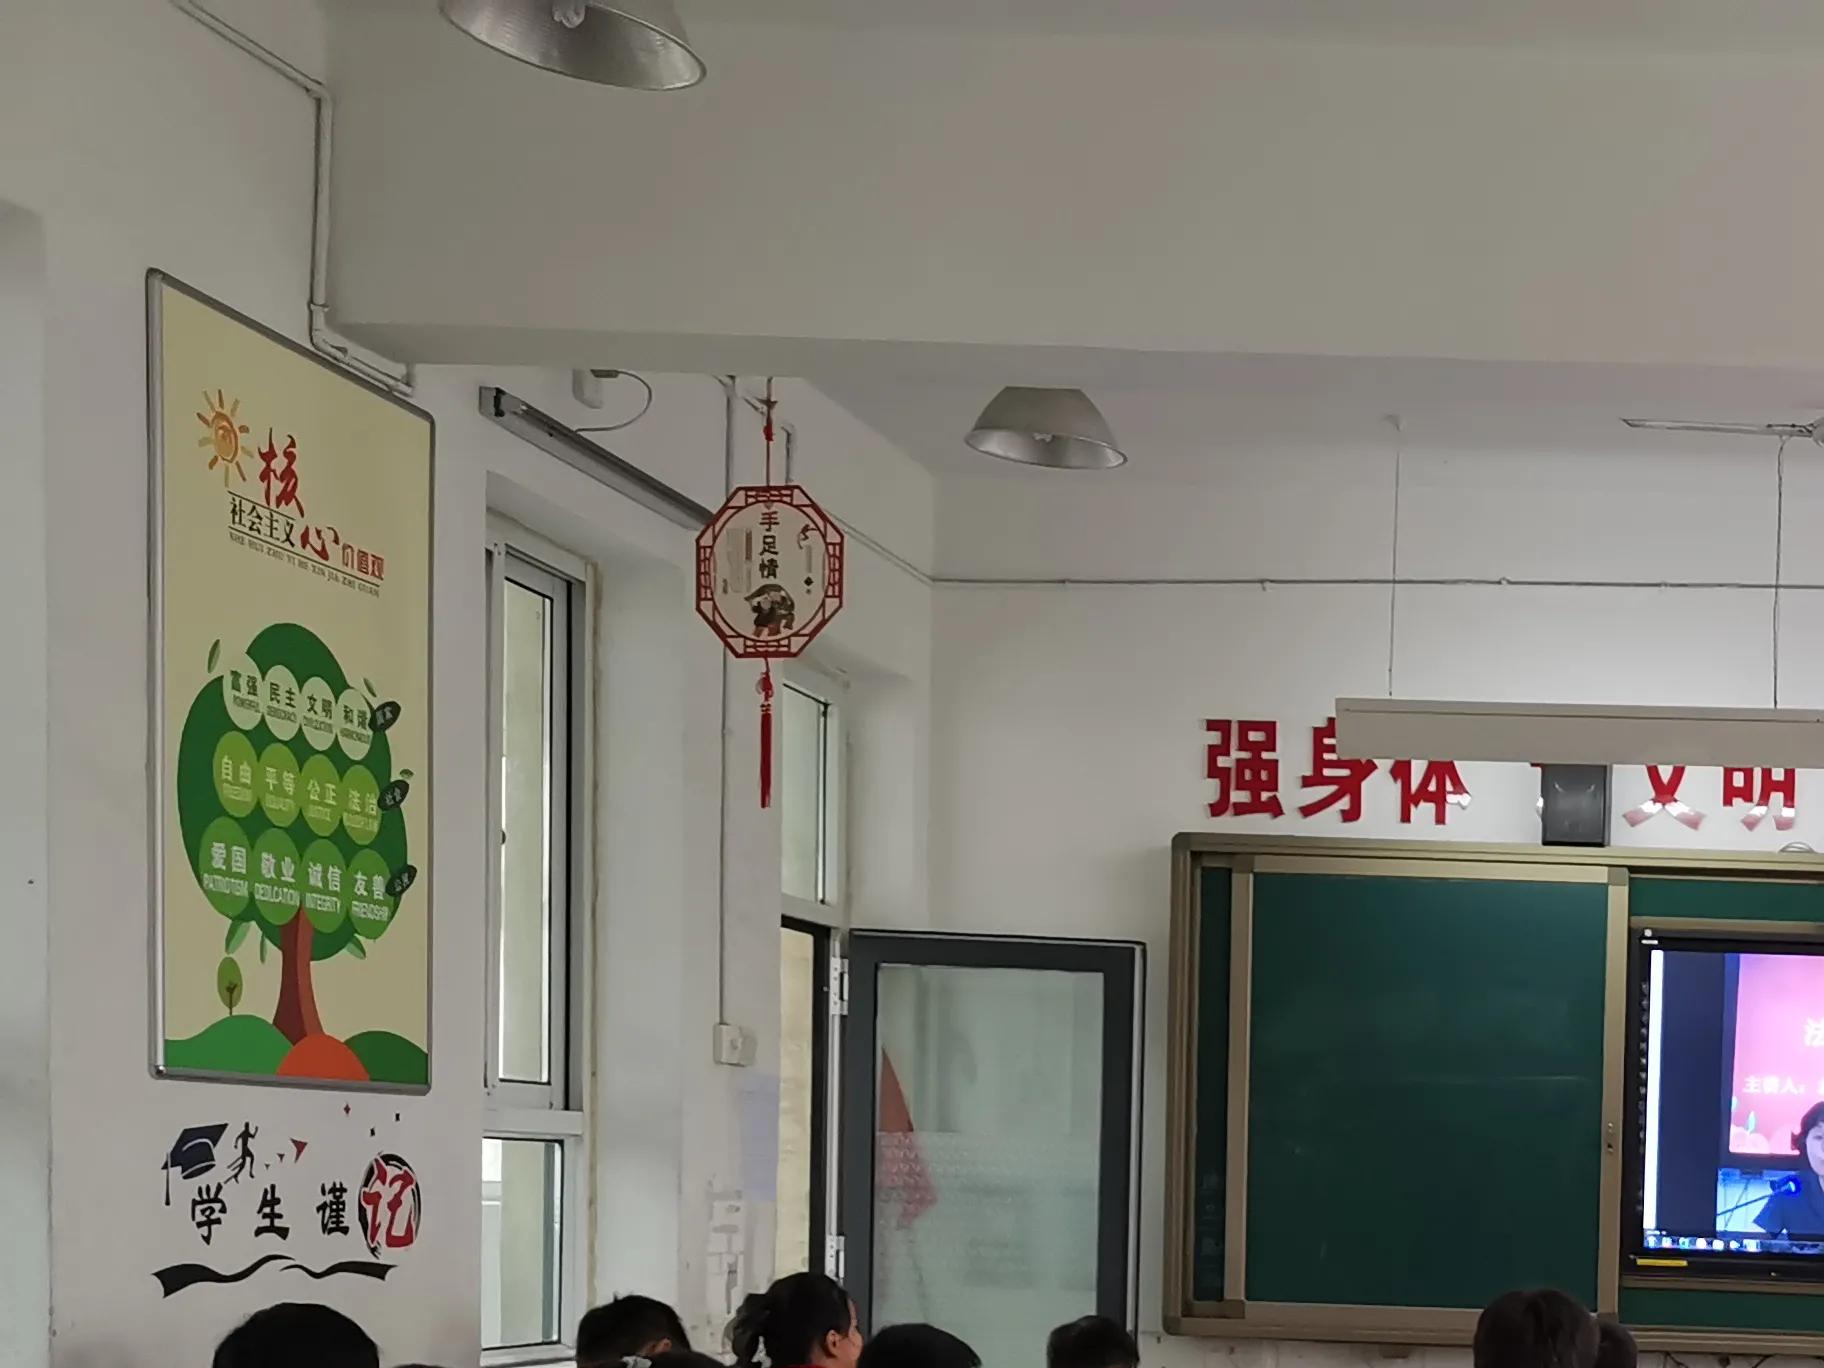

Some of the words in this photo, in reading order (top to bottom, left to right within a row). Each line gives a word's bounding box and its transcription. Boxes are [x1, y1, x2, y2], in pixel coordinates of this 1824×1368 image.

[230, 497, 295, 547] 社会主义
[759, 511, 780, 579] 手足情
[269, 682, 296, 709] 民主
[307, 779, 337, 806] 公正
[211, 842, 247, 875] 爱国
[261, 852, 296, 883] 敬业
[308, 861, 342, 892] 诚信
[354, 870, 386, 901] 友善
[191, 1157, 415, 1249] 学生谨记
